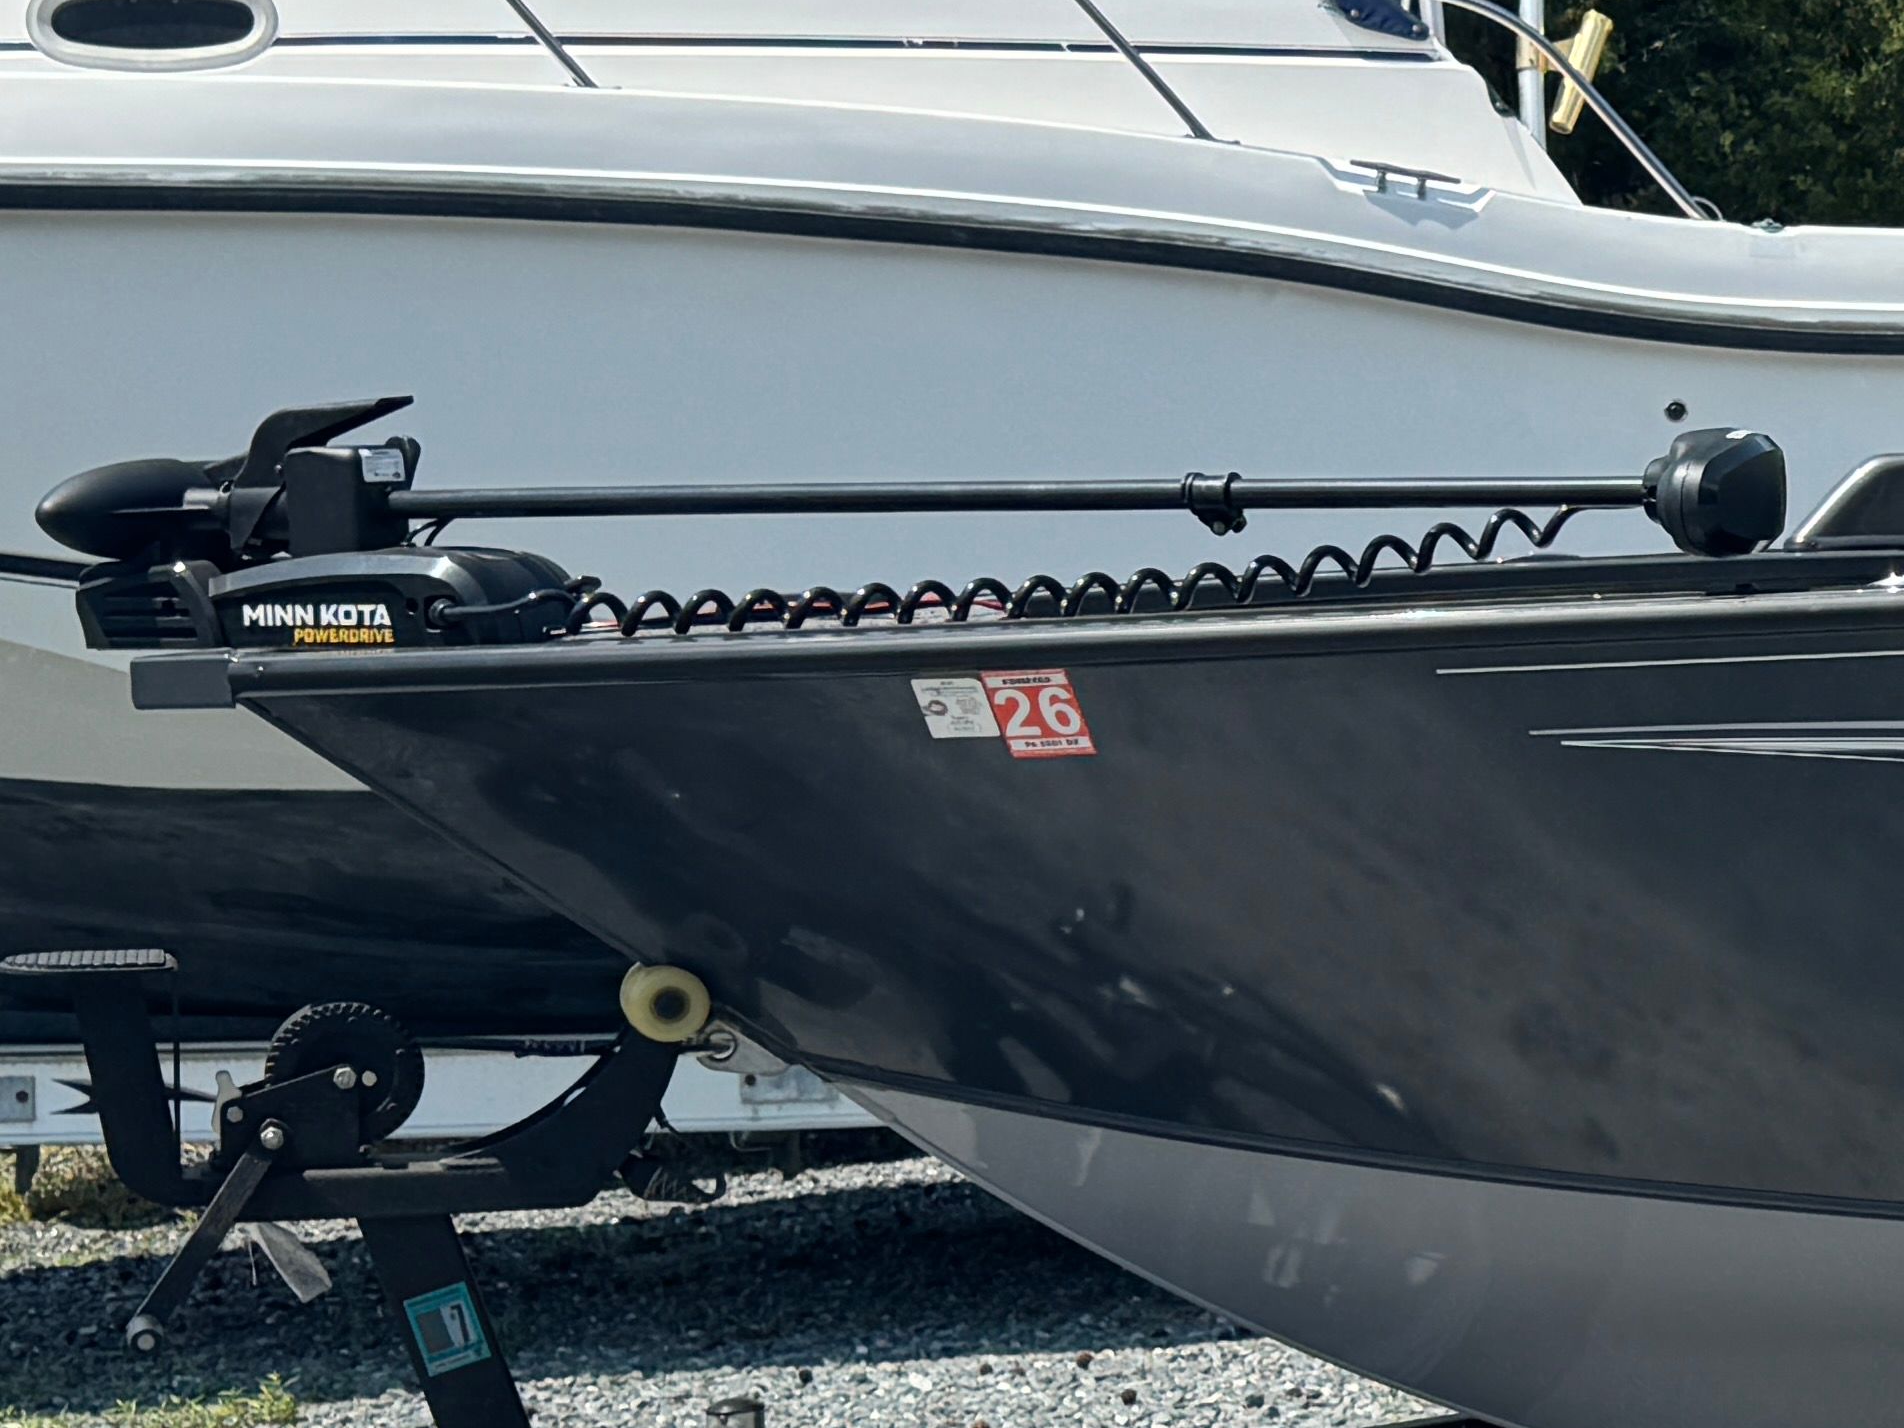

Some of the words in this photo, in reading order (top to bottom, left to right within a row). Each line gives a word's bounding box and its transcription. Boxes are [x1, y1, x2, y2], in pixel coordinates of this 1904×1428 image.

[242, 603, 314, 627] MINN
[319, 603, 392, 626] KOTA
[293, 628, 394, 645] POWERDRIVE
[994, 686, 1081, 737] 26
